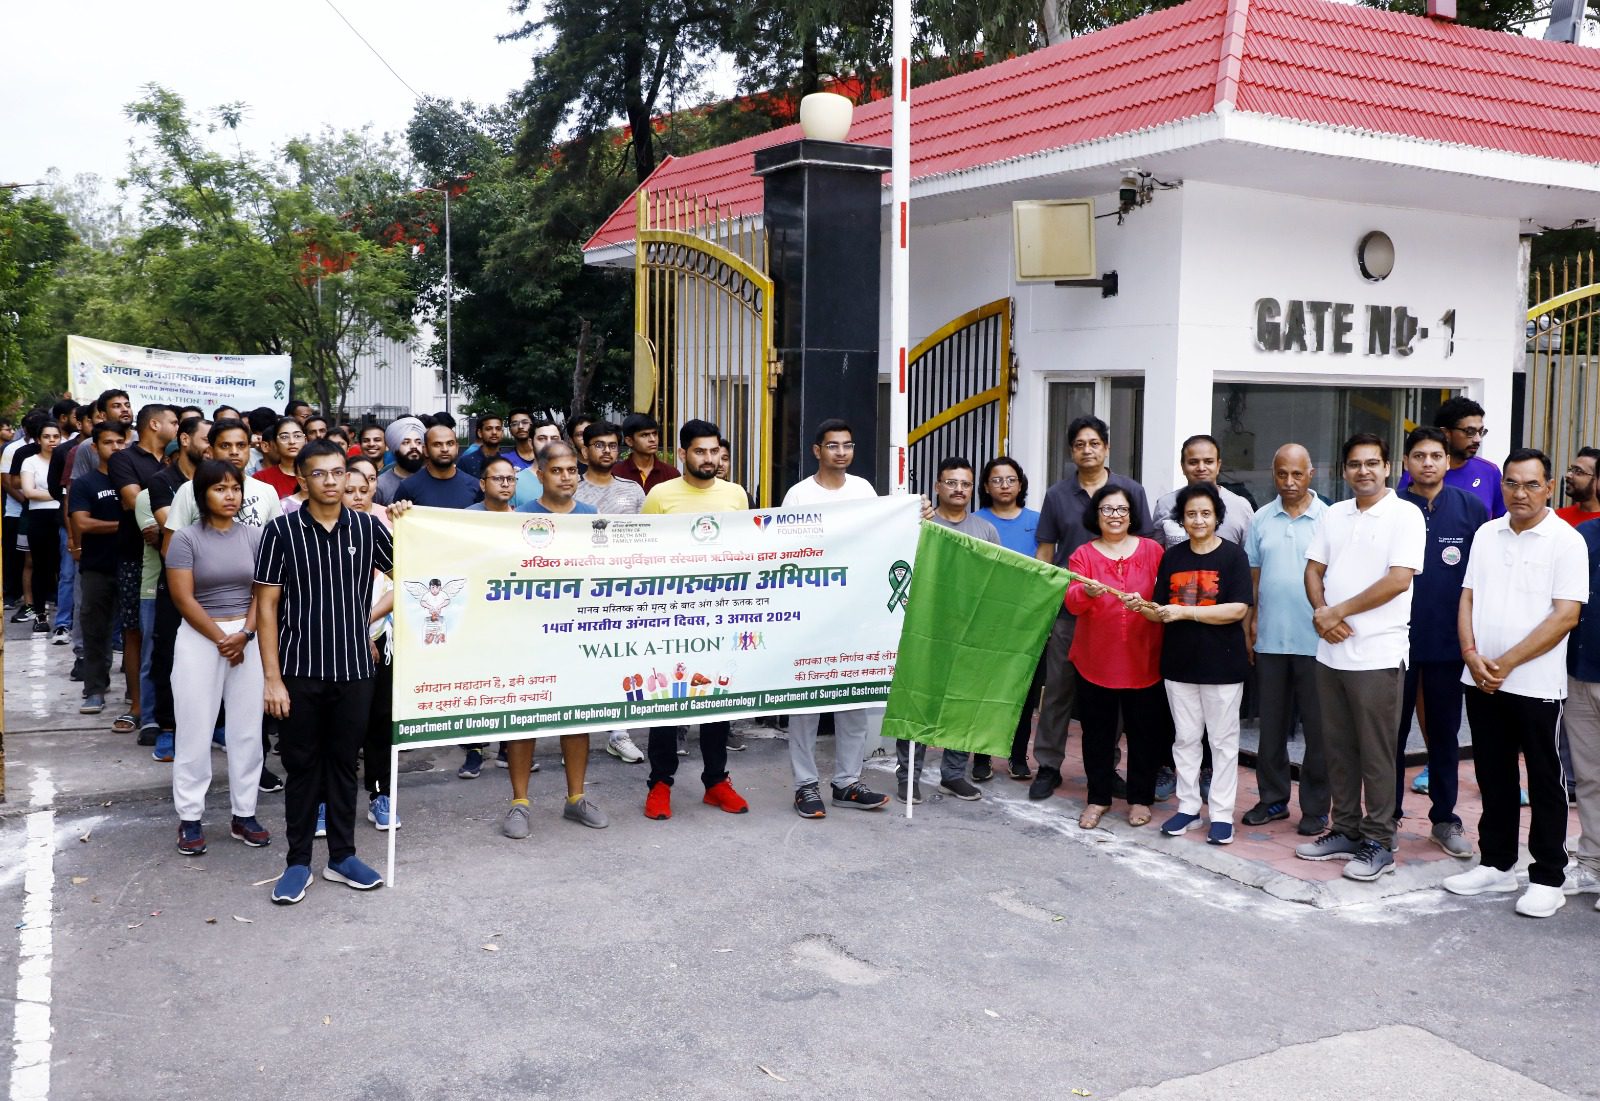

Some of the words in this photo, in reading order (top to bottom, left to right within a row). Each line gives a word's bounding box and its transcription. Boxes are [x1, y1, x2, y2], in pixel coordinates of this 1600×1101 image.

[1255, 298, 1354, 354] GATE
[102, 363, 140, 377] अंगदान
[215, 375, 256, 387] अभियान
[776, 513, 823, 525] MOHAN
[777, 527, 824, 535] FOUNDATION
[520, 555, 560, 568] अखिल
[563, 554, 605, 567] भारतीय
[609, 553, 666, 569] आयुर्विज्ञान
[668, 553, 707, 565] संस्थान
[757, 552, 777, 562] द्वारा
[780, 547, 824, 560] आयोजित
[486, 572, 584, 601] अंगदान
[590, 571, 751, 598] जनजागरुकता
[755, 563, 848, 590] अभियान
[577, 606, 599, 614] मानव
[602, 603, 633, 613] मस्तिष्क
[637, 602, 648, 612] की
[651, 603, 667, 613] मृत्यु
[670, 601, 678, 610] के
[681, 601, 695, 609] बाद
[698, 599, 712, 608] अंग
[715, 597, 729, 607] और
[732, 598, 753, 607] ऊतक
[755, 597, 770, 606] दान
[577, 618, 622, 631] भारतीय
[626, 616, 671, 629] अंगदान
[674, 614, 710, 627] दिवस,
[715, 614, 723, 625] 3
[727, 613, 763, 624] अगस्त
[767, 611, 801, 622] 2024
[578, 641, 638, 659] 'WALK
[644, 636, 725, 655] A-THON'
[793, 656, 822, 667] आपका
[824, 656, 838, 666] एक
[839, 652, 864, 663] निर्णय
[866, 651, 880, 662] कई
[882, 650, 897, 661] लोग
[413, 681, 451, 694] अंगदान
[454, 680, 491, 691] महादान
[493, 676, 506, 688] है,
[509, 675, 525, 686] इसे
[528, 674, 557, 685] अपना
[795, 672, 806, 682] की
[808, 670, 838, 681] जिन्दगी
[841, 669, 859, 678] बदल
[861, 667, 886, 676] सकता
[399, 720, 451, 736] Department
[454, 719, 463, 729] of
[466, 717, 500, 730] Urology
[510, 712, 561, 726] Department
[564, 710, 572, 721] of
[574, 707, 621, 720] Nephrology
[630, 702, 678, 716] Department
[681, 700, 689, 711] of
[691, 697, 756, 711] Gastroenterology
[765, 689, 808, 704] Department
[810, 689, 818, 700] of
[820, 687, 850, 701] Surgical
[851, 685, 891, 696] Gastroente
[417, 701, 433, 711] कर
[435, 696, 461, 712] दूसरों
[464, 696, 477, 707] की
[480, 693, 516, 705] जिन्दगी
